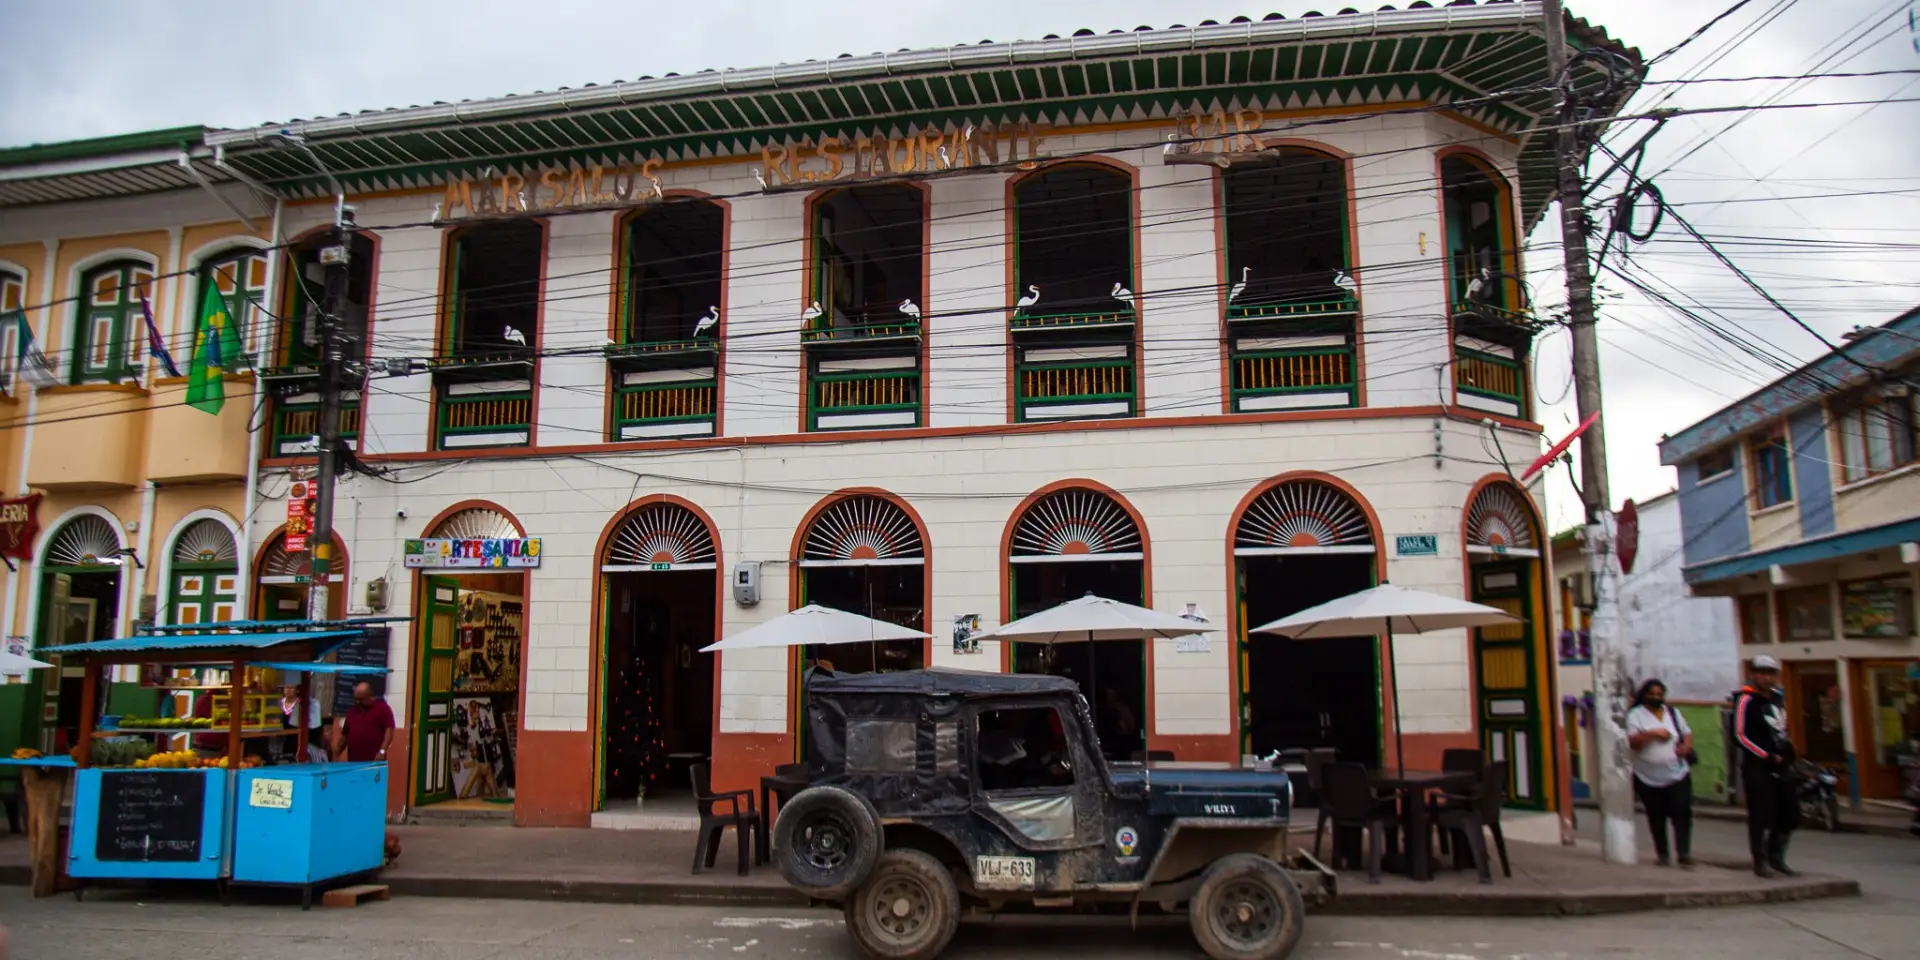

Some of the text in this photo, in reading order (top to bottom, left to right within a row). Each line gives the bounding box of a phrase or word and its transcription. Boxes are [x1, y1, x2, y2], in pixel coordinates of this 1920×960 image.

[761, 121, 1051, 187] RESTAURANTE
[1176, 108, 1267, 154] BAR
[441, 540, 539, 558] ARTESANIAS
[980, 859, 1033, 877] VLJ-633
